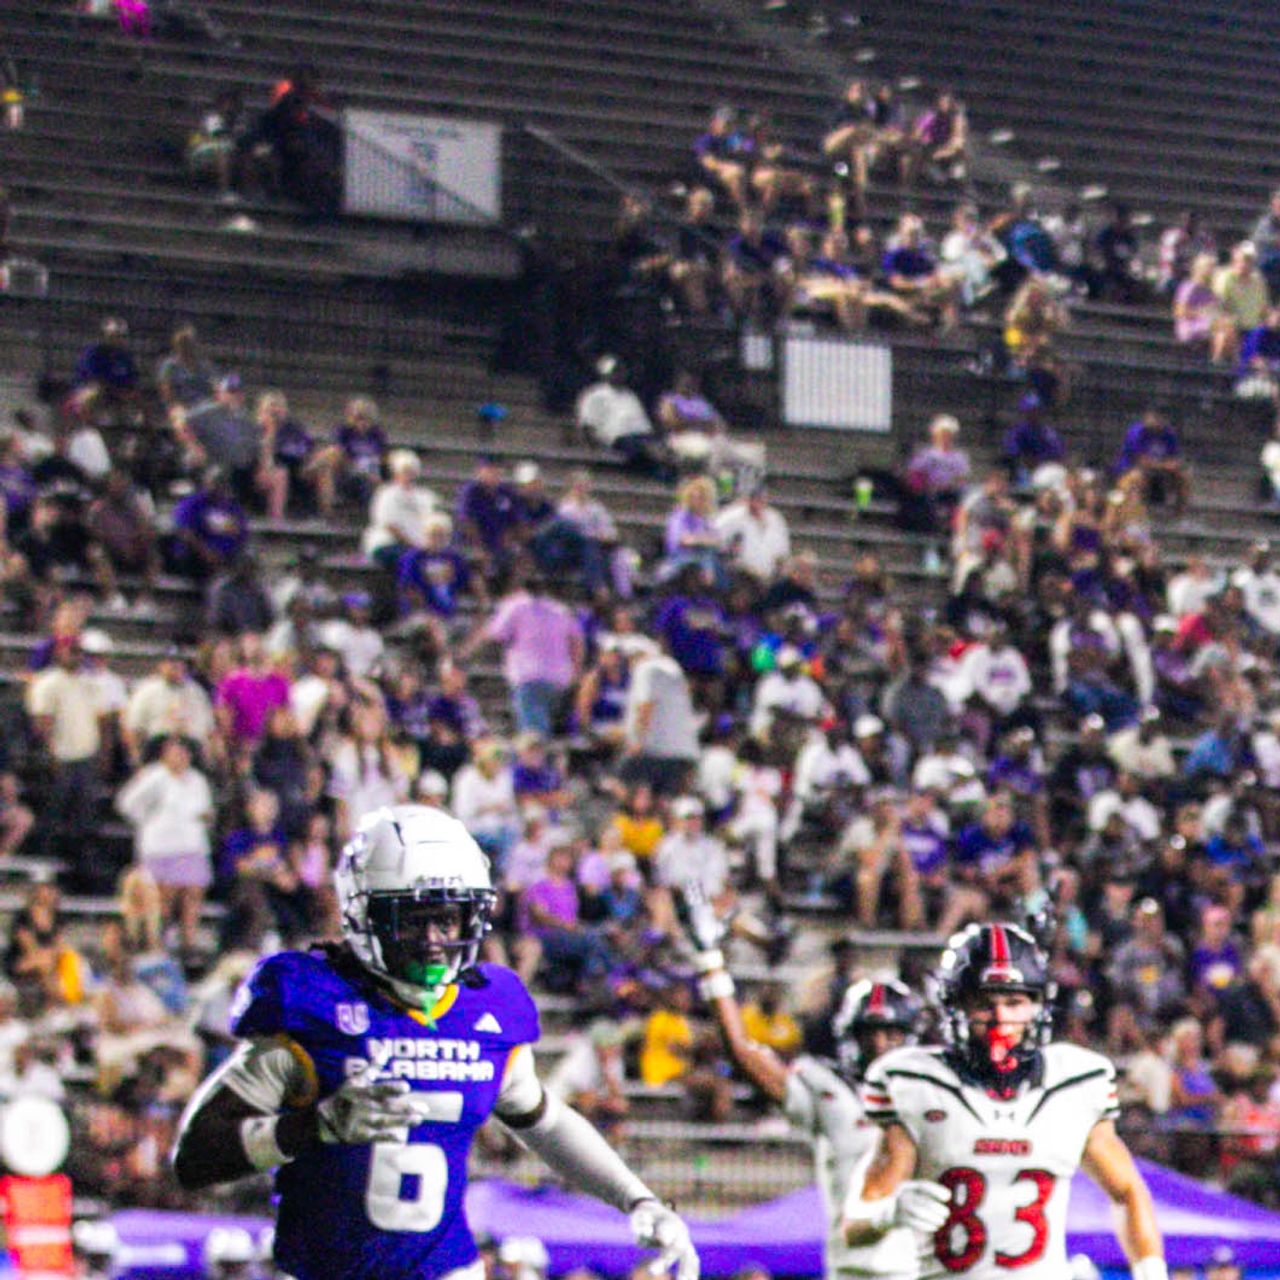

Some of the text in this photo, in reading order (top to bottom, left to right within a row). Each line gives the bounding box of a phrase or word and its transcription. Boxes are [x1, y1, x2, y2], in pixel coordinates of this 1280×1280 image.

[367, 1038, 481, 1063] NORTH
[366, 1090, 464, 1233] 6
[934, 1165, 1058, 1272] 83
